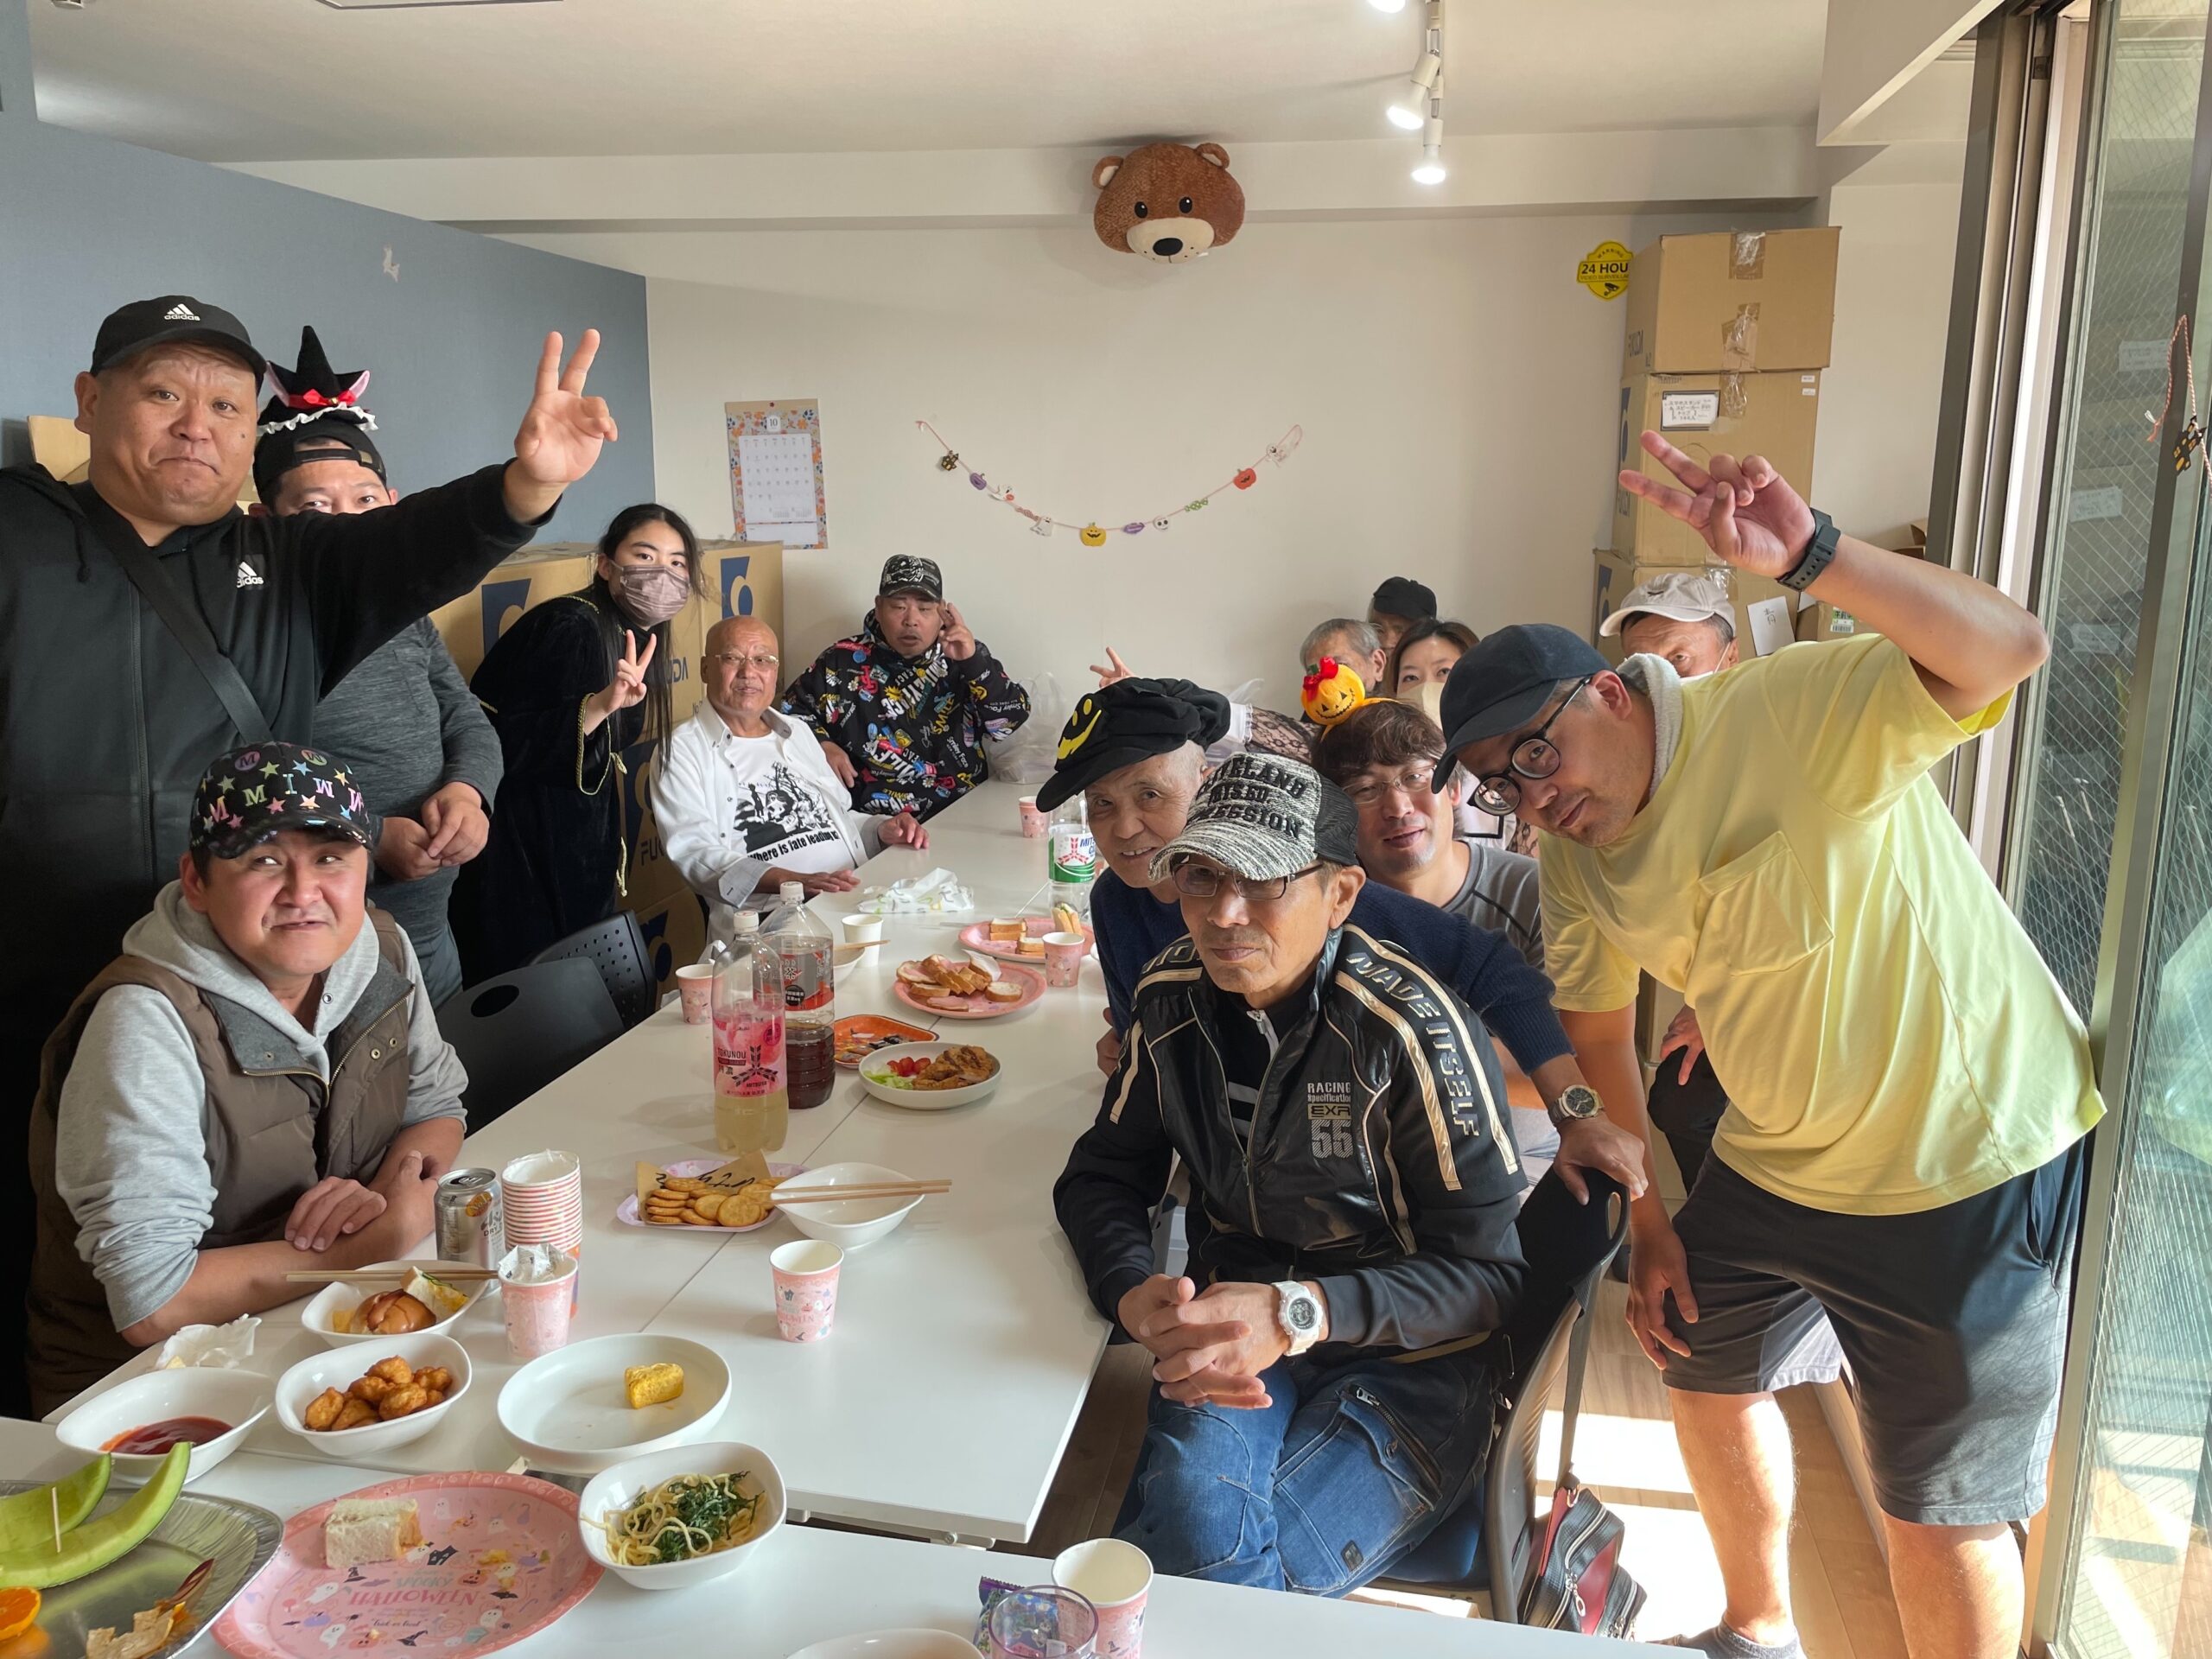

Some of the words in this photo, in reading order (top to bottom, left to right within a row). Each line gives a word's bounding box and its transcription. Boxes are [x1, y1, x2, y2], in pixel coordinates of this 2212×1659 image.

[1581, 264, 1596, 274] 24
[1599, 263, 1629, 274] HOU
[769, 418, 779, 427] 10
[779, 843, 789, 855] is
[789, 838, 807, 851] fate
[1345, 951, 1440, 1019] MADE
[1426, 1020, 1480, 1137] ITSELF
[718, 1047, 747, 1059] TOKUNOU
[1307, 1082, 1351, 1093] RACING
[484, 1227, 498, 1236] DRY
[348, 1588, 480, 1605] HALLOWEEN
